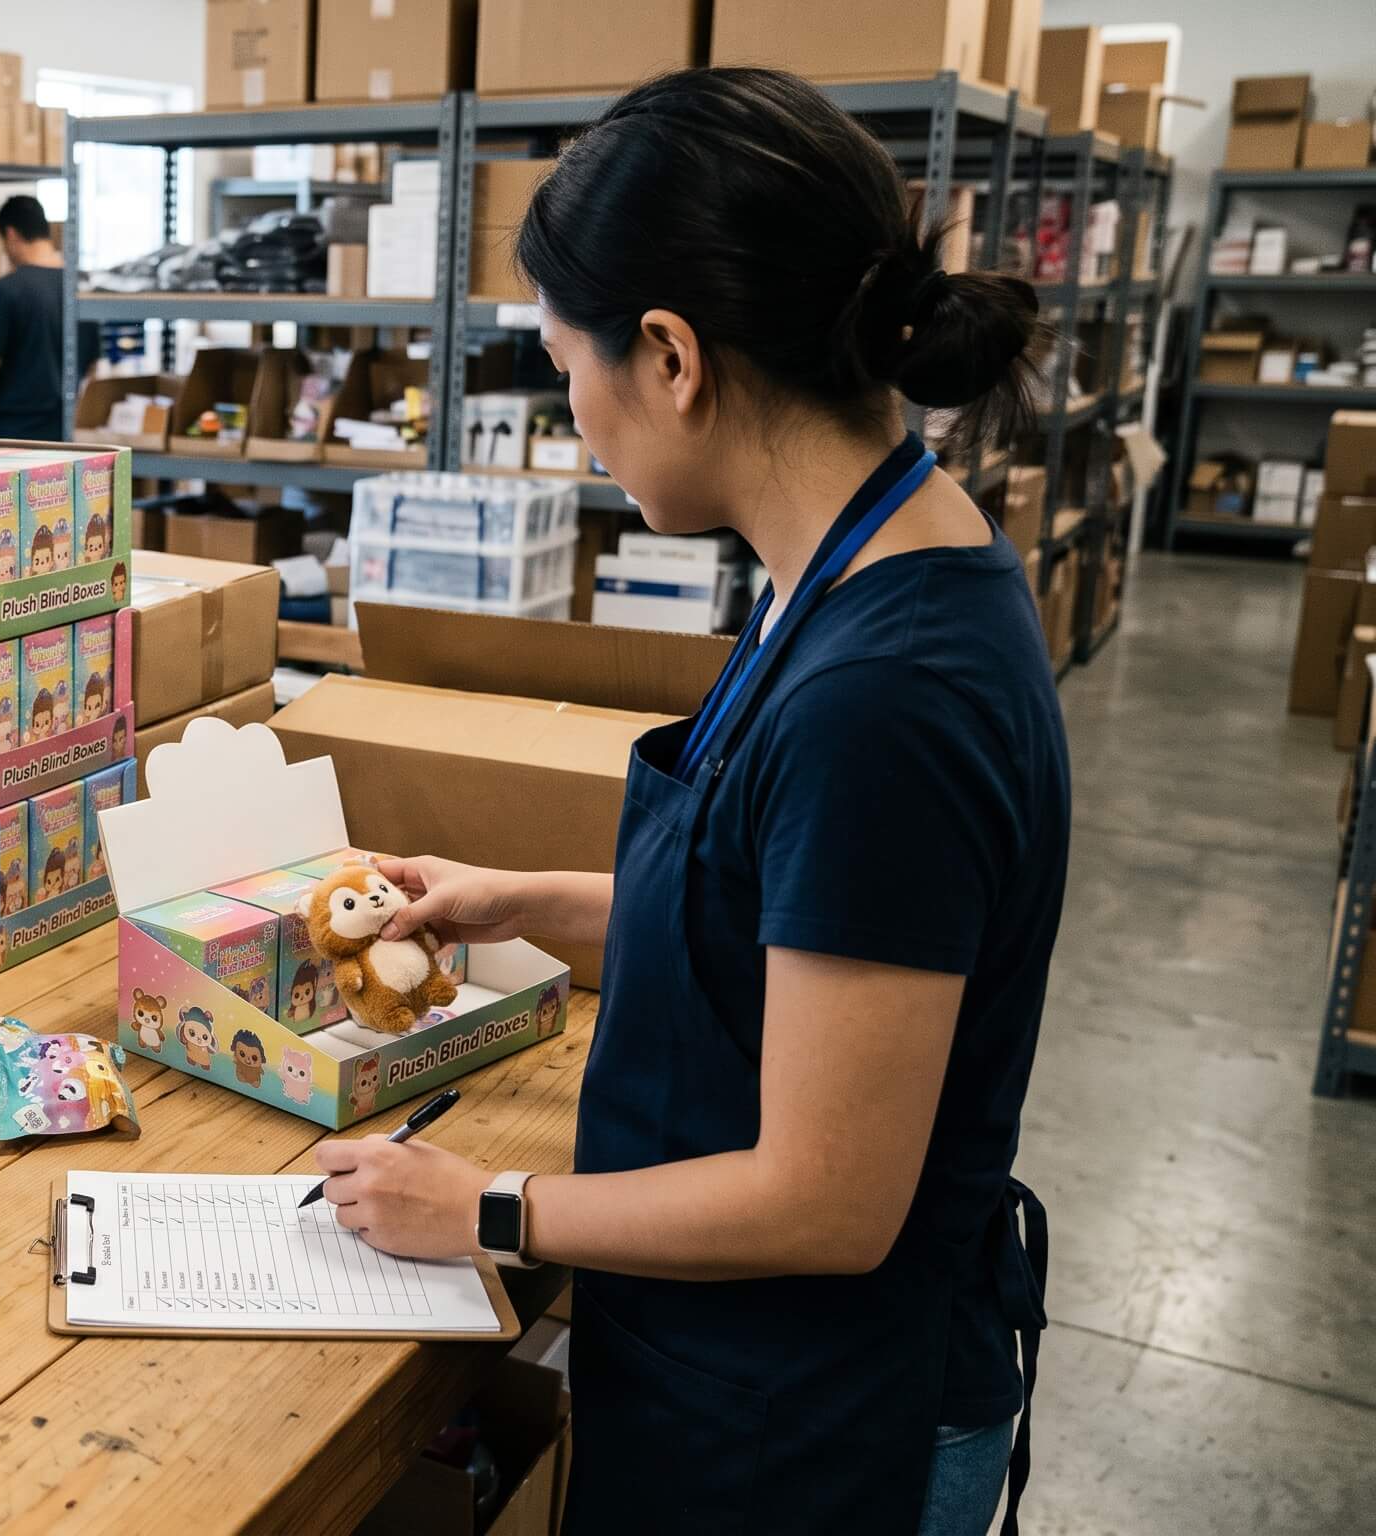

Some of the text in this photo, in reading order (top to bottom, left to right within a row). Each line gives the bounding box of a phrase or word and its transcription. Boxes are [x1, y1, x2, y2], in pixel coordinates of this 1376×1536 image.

[2, 582, 105, 619] Plush Blind Boxes
[3, 740, 106, 786] Plush Blind Boxes
[12, 922, 47, 947] Plush
[50, 904, 81, 930] Blind
[388, 1011, 529, 1084] Plush Blind Boxes
